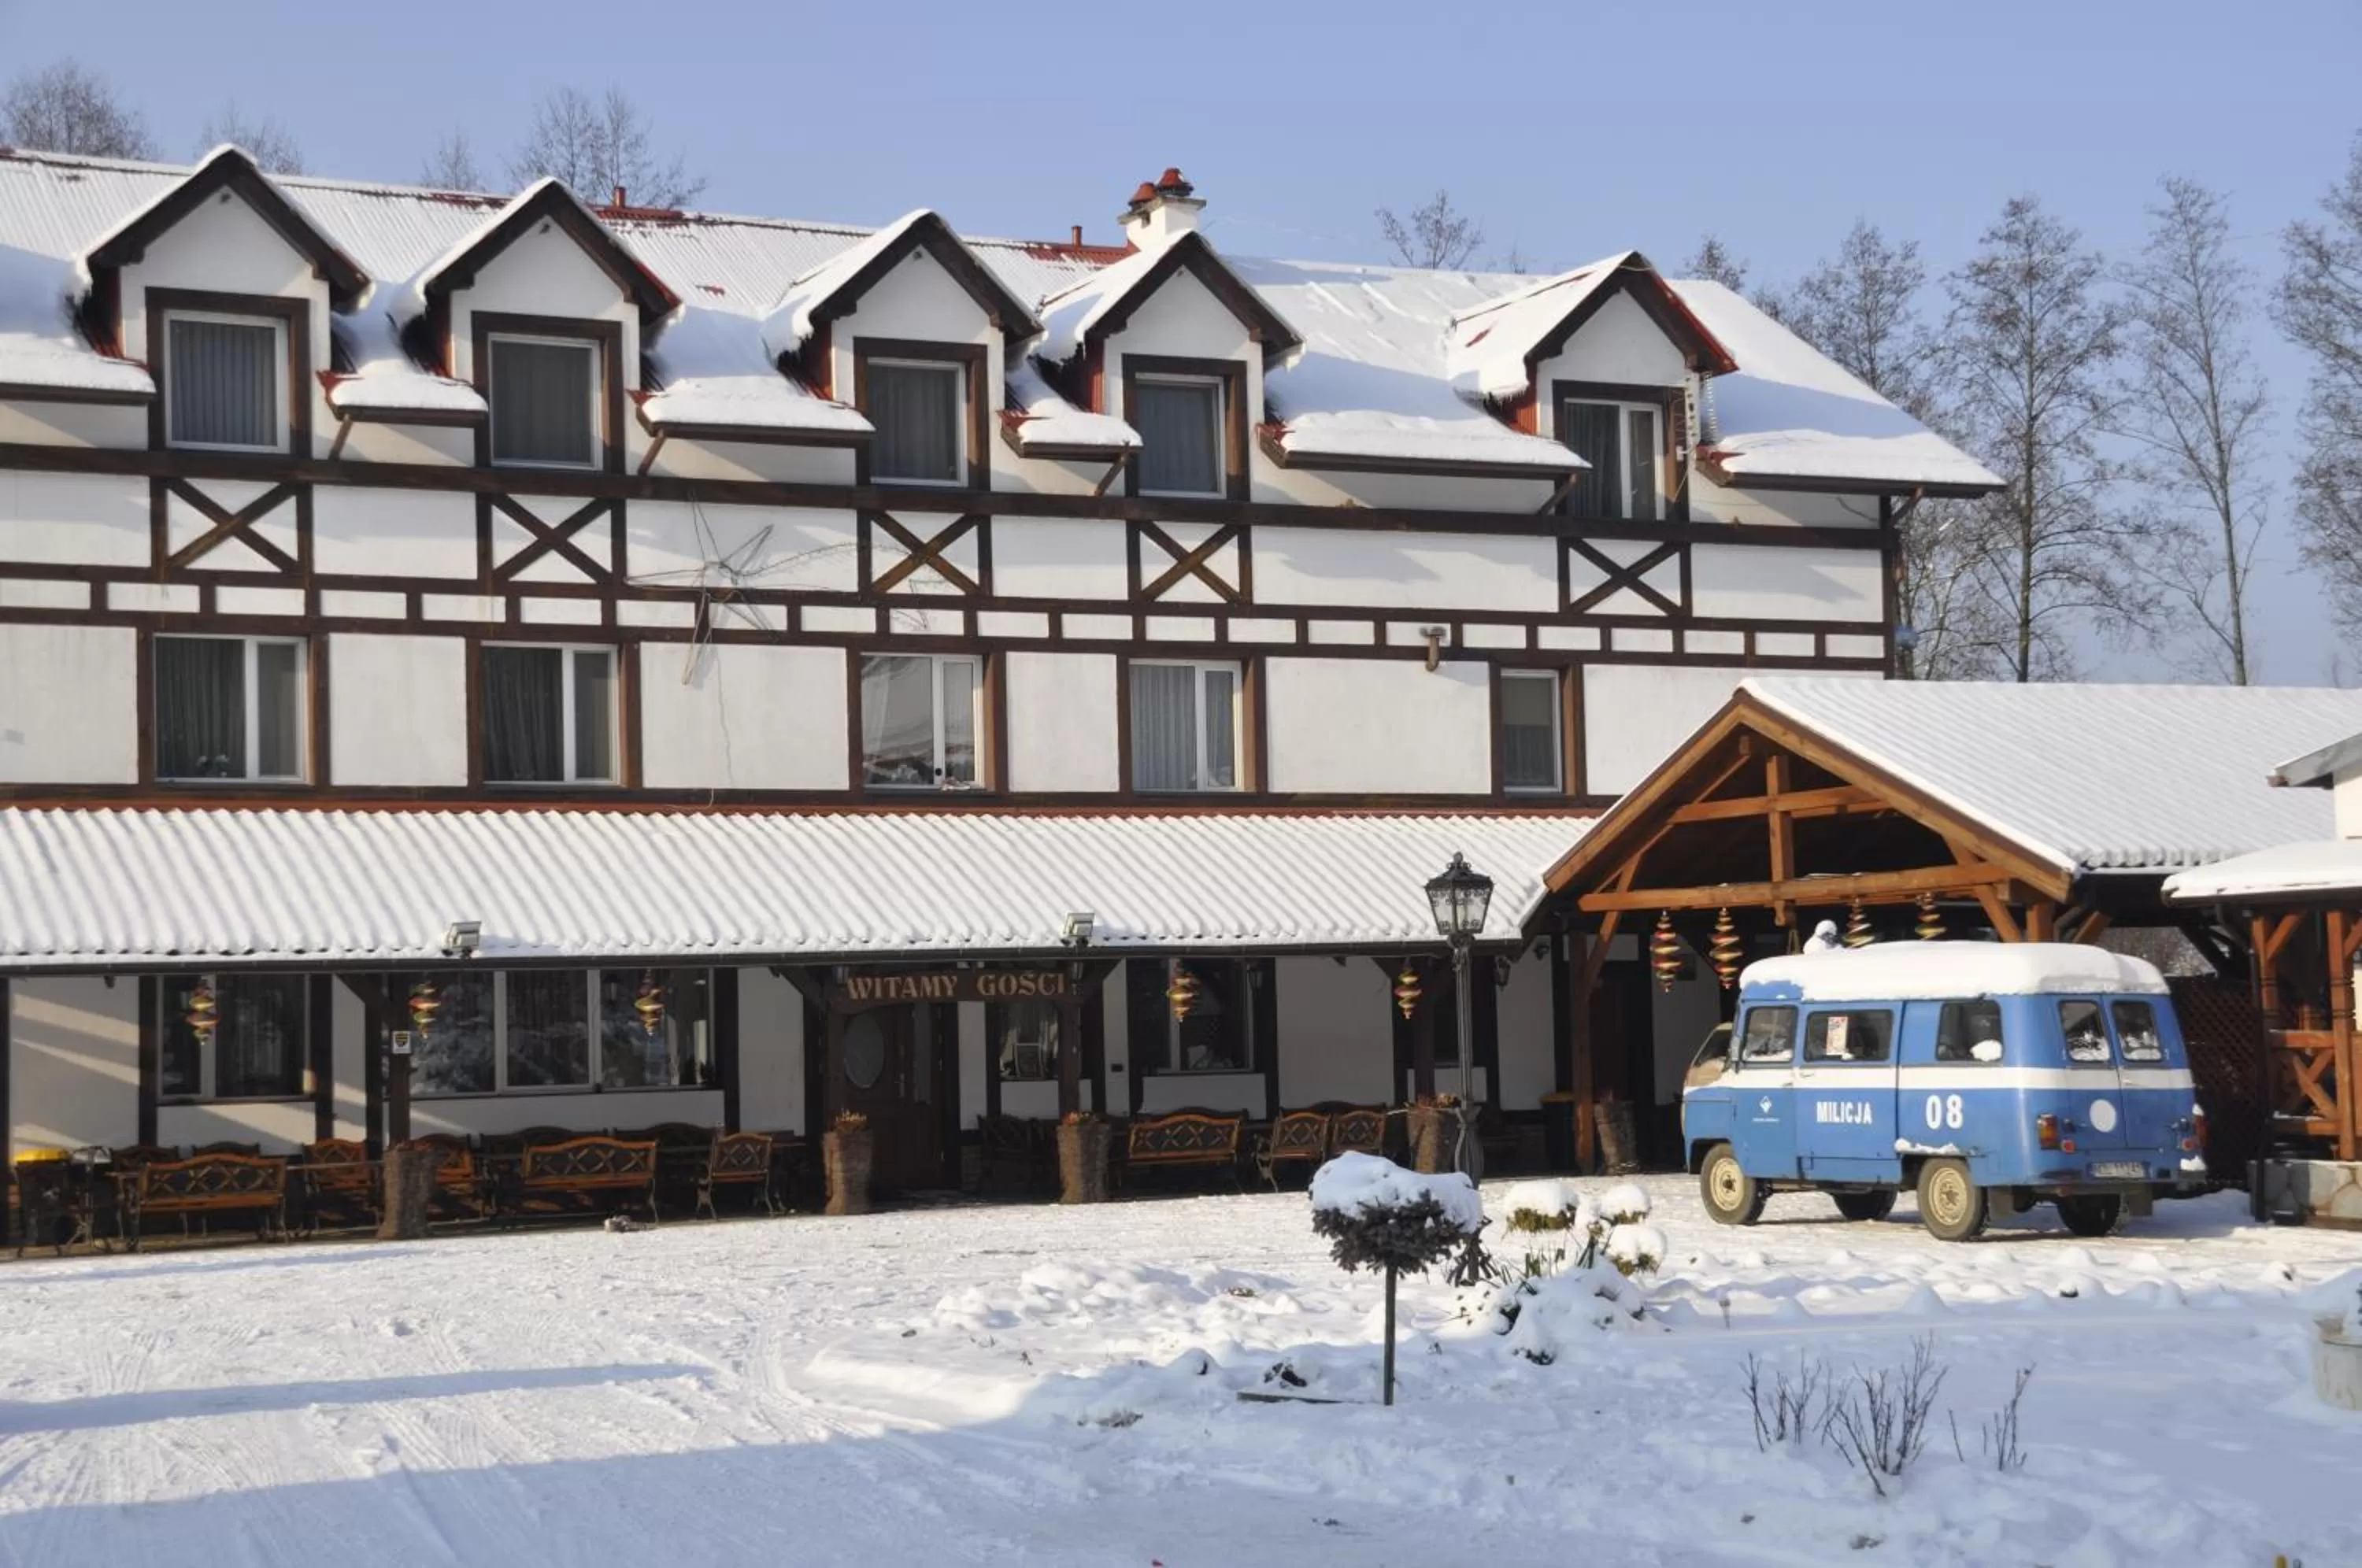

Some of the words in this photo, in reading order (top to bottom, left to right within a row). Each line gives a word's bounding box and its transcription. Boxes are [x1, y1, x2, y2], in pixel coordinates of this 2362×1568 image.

[846, 976, 957, 999] WITAMY
[1816, 1101, 1872, 1124] MILICJA
[1926, 1093, 1964, 1130] 08
